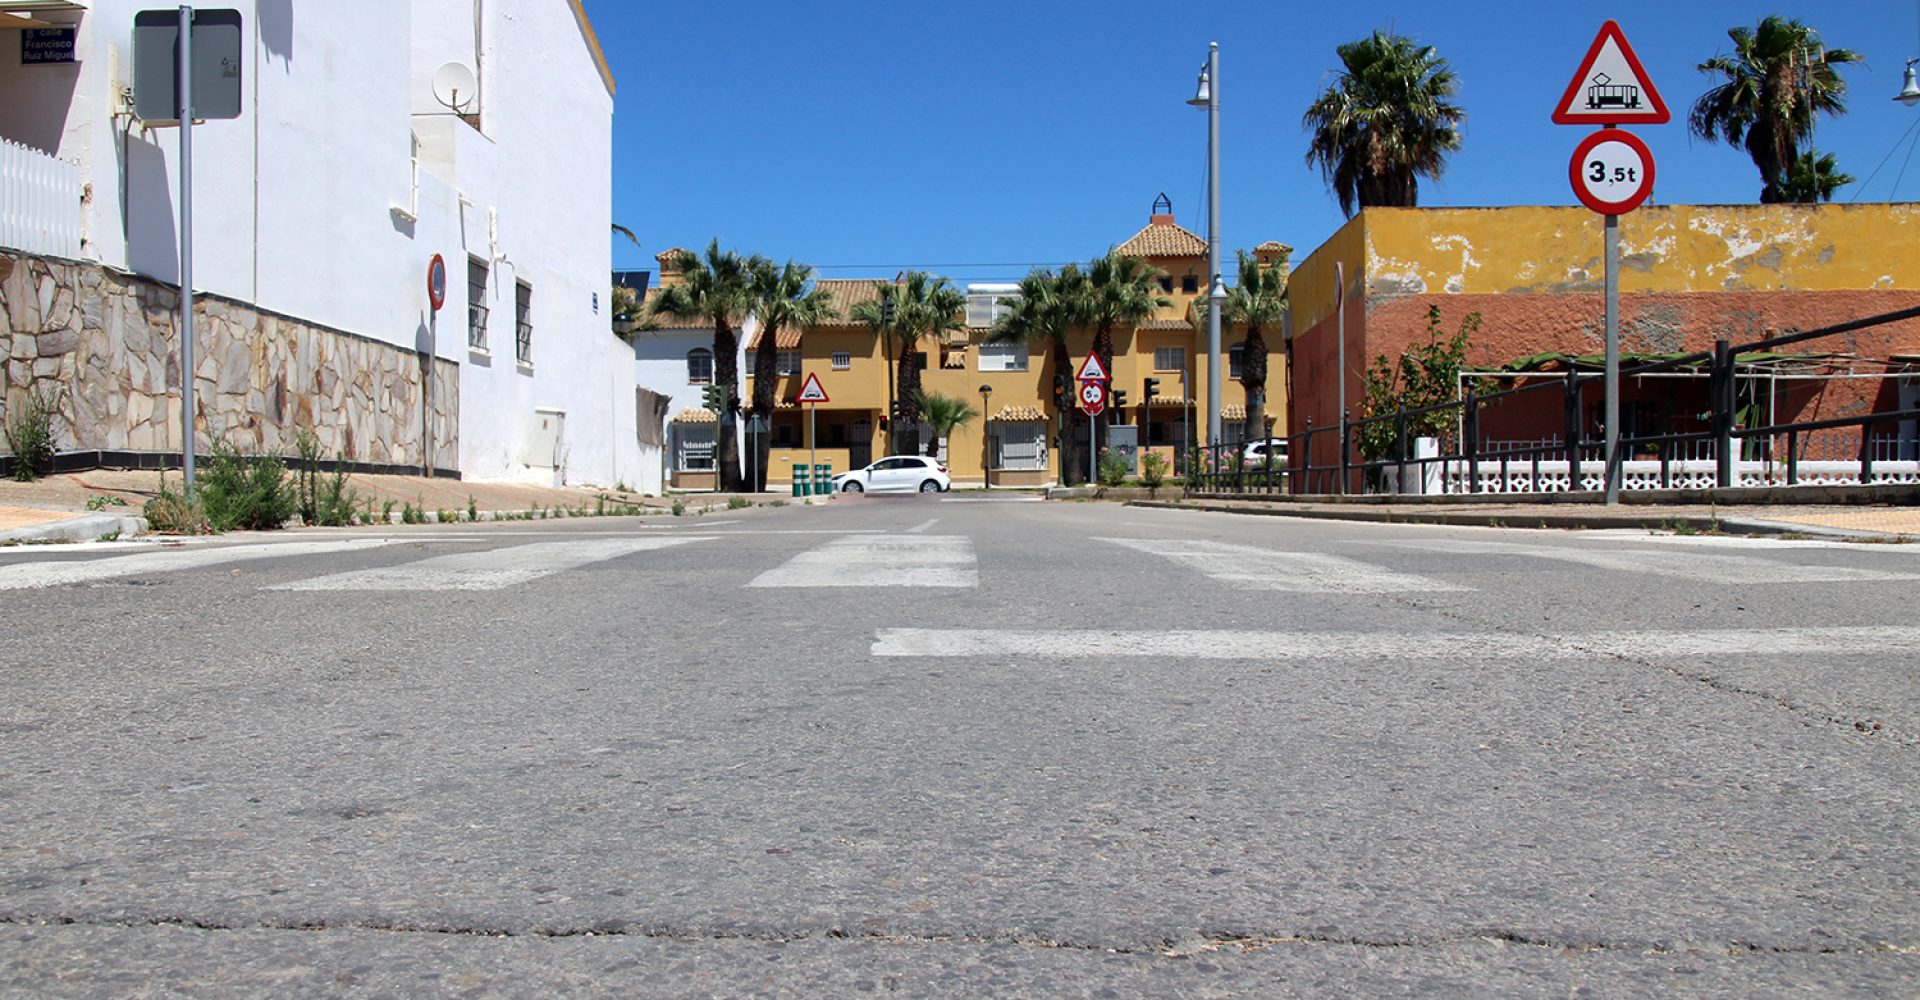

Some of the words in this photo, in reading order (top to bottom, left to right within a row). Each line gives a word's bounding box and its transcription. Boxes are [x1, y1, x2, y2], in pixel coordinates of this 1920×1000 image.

[25, 40, 72, 49] Francisco
[23, 51, 41, 60] Ruiz
[44, 50, 74, 61] Miguel
